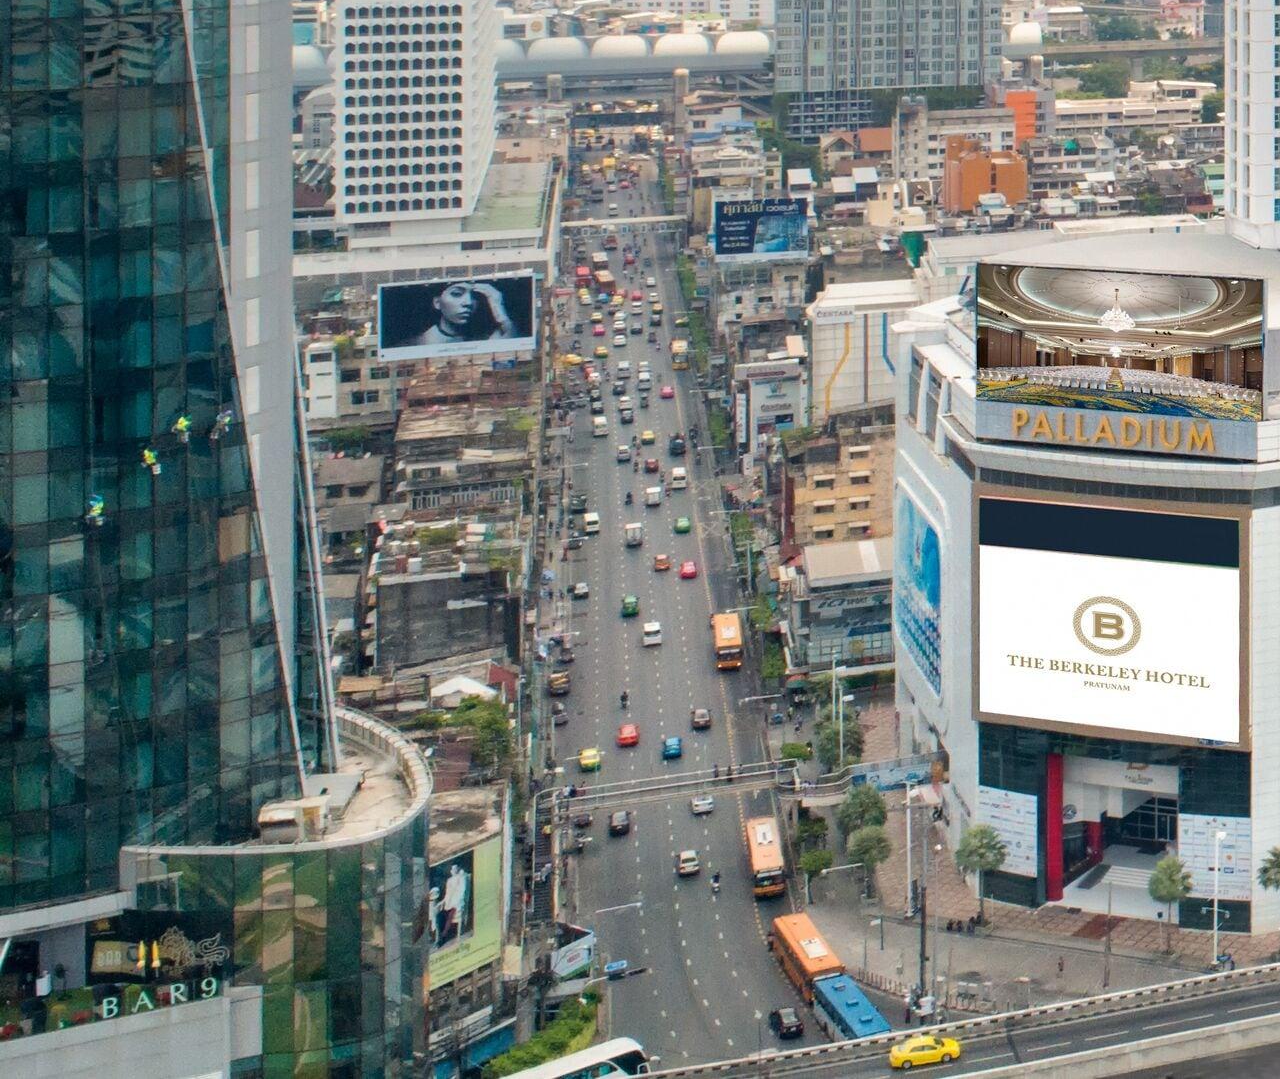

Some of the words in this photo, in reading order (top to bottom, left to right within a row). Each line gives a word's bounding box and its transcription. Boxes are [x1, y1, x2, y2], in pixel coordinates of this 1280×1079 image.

[1011, 408, 1216, 453] PALLADIUM
[1092, 610, 1125, 640] B
[1006, 654, 1045, 670] THE
[1049, 659, 1142, 681] BERKELEY
[1145, 670, 1210, 689] HOTEL
[1083, 680, 1131, 692] PRATUNAM
